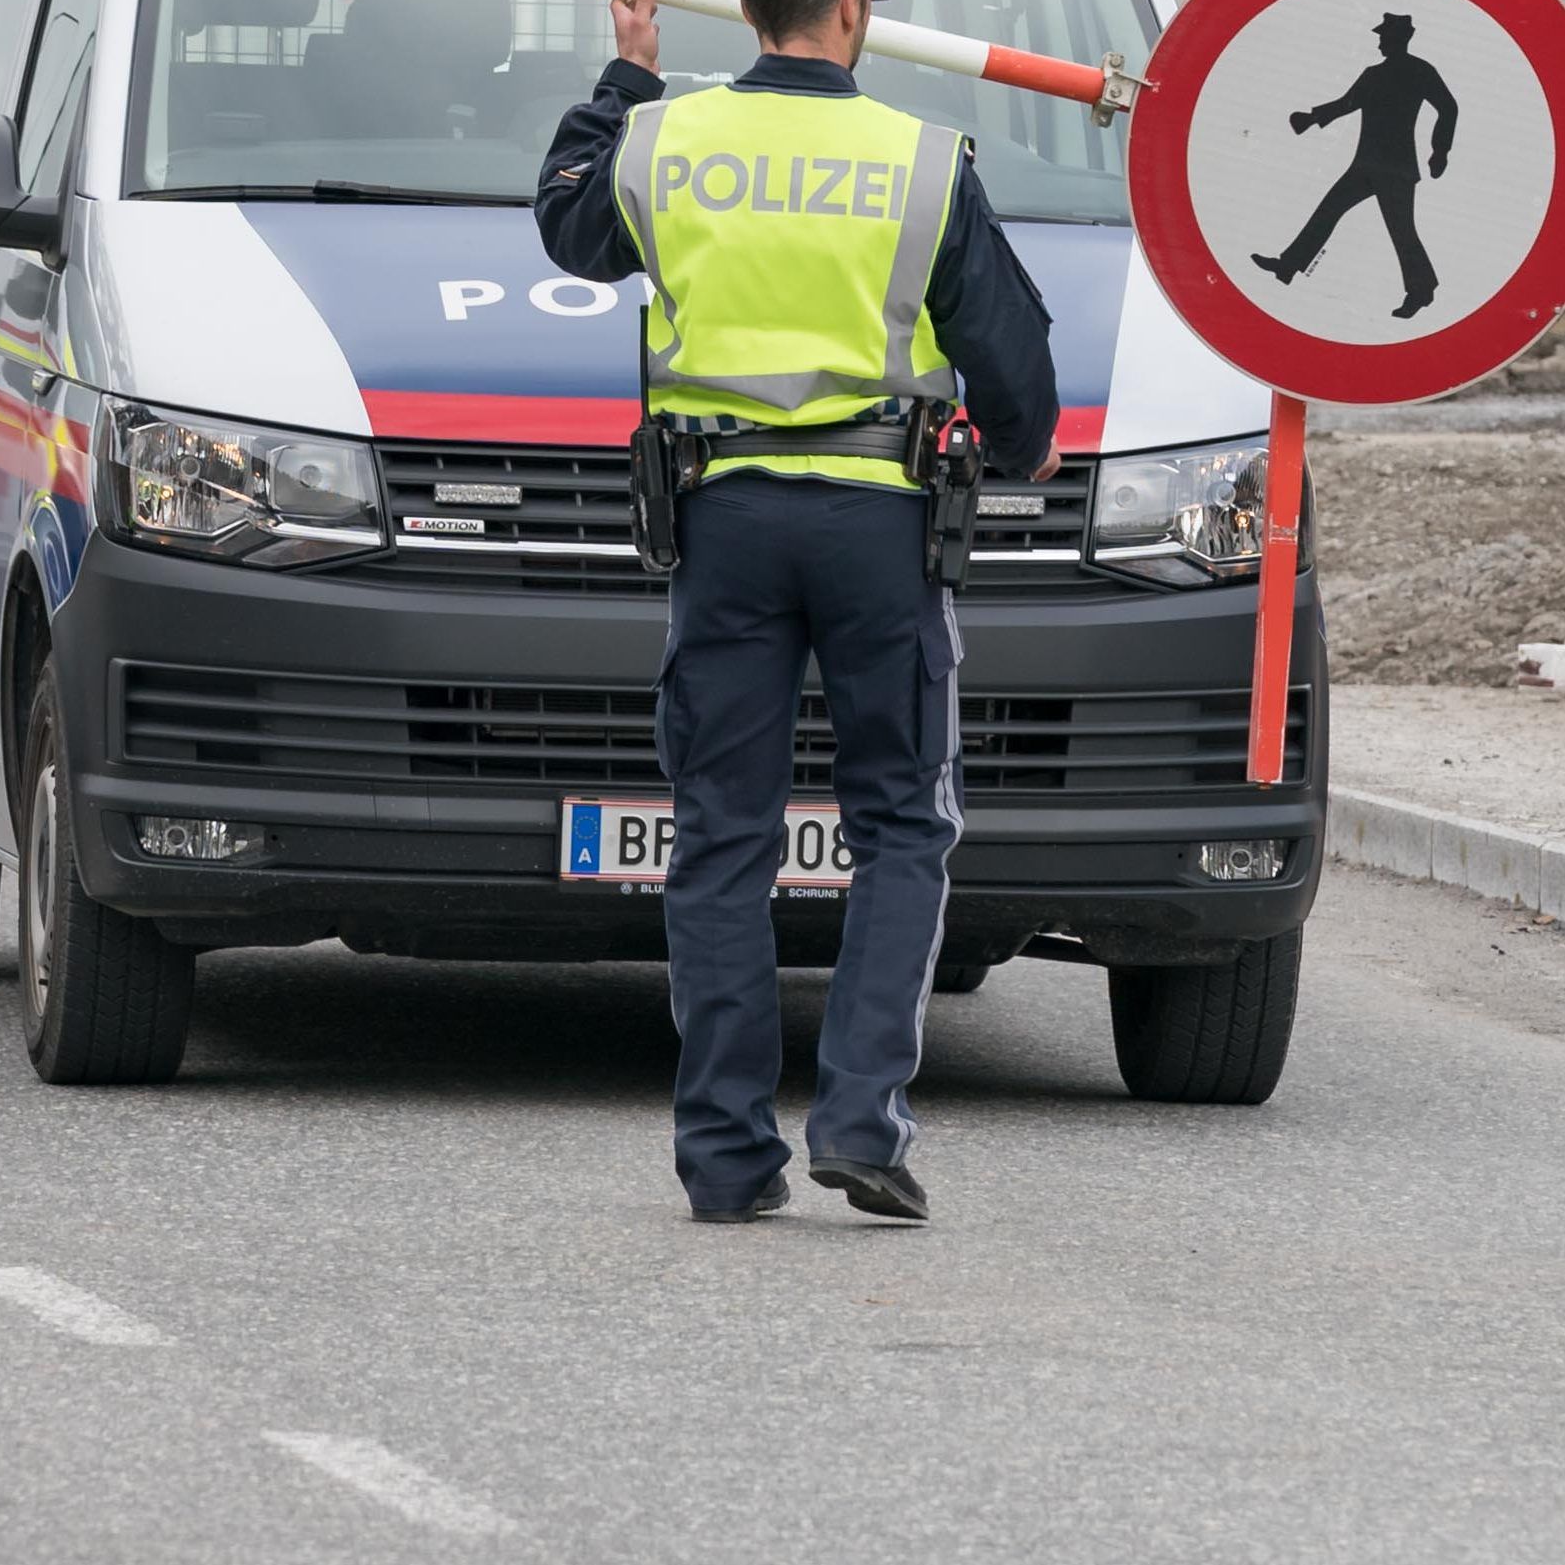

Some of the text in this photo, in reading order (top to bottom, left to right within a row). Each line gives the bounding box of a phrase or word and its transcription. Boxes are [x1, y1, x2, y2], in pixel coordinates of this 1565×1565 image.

[655, 153, 907, 221] POLIZEI
[578, 847, 593, 864] A
[619, 816, 676, 867] BP
[788, 888, 839, 899] SCHRUNS
